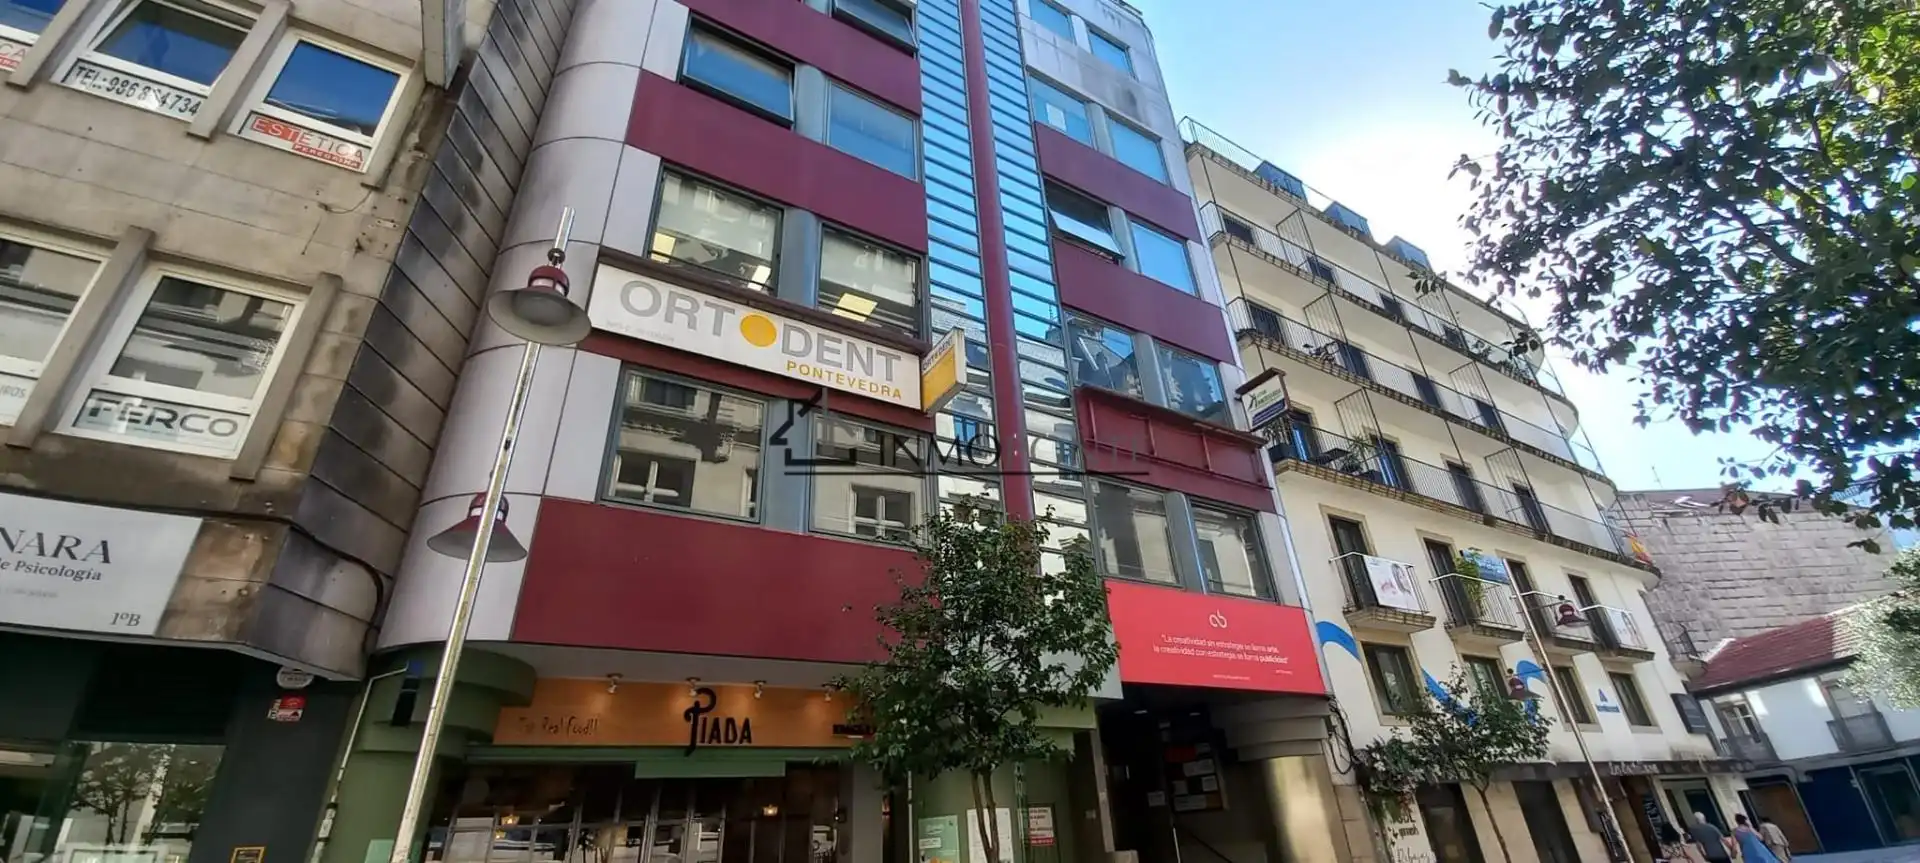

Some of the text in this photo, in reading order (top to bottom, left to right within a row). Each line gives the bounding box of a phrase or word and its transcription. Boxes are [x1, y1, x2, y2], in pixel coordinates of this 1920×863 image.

[786, 360, 902, 399] PONTEVEDRA
[88, 398, 238, 437] FERCO
[14, 559, 103, 582] Psicología
[684, 687, 753, 757] PIADA
